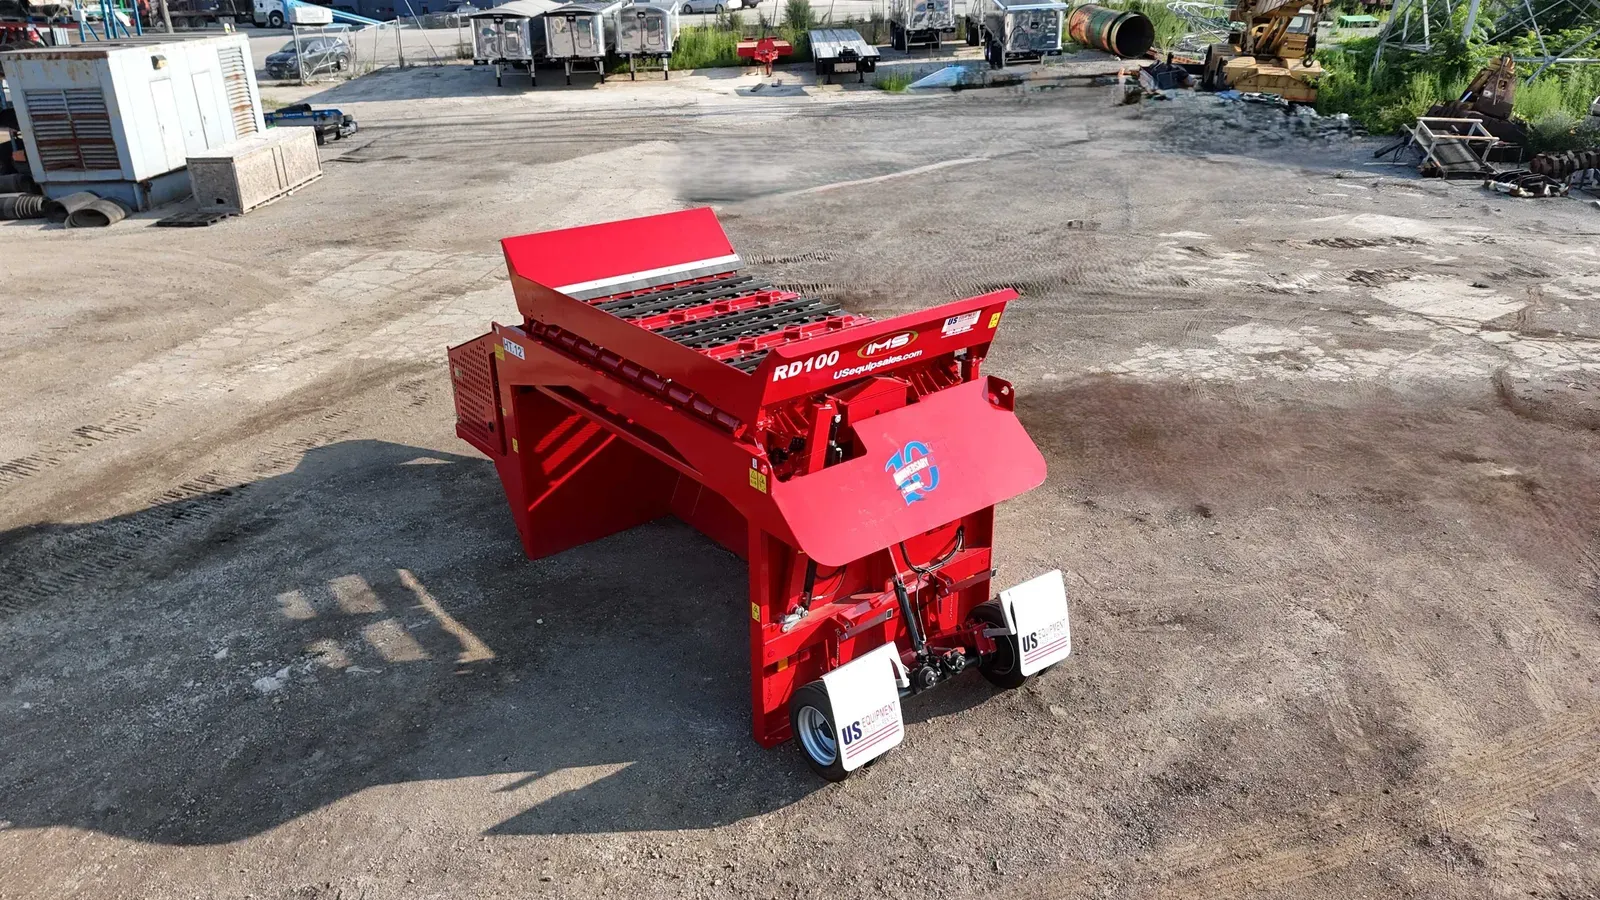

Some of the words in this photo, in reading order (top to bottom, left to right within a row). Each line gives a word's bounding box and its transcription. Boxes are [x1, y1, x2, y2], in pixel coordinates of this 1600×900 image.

[947, 316, 959, 326] US
[866, 332, 911, 356] IMS
[772, 350, 840, 382] RD100
[833, 349, 923, 380] USequipsales.com
[1022, 631, 1038, 653] US
[841, 720, 863, 746] US
[861, 700, 897, 729] EQUIPMENT
